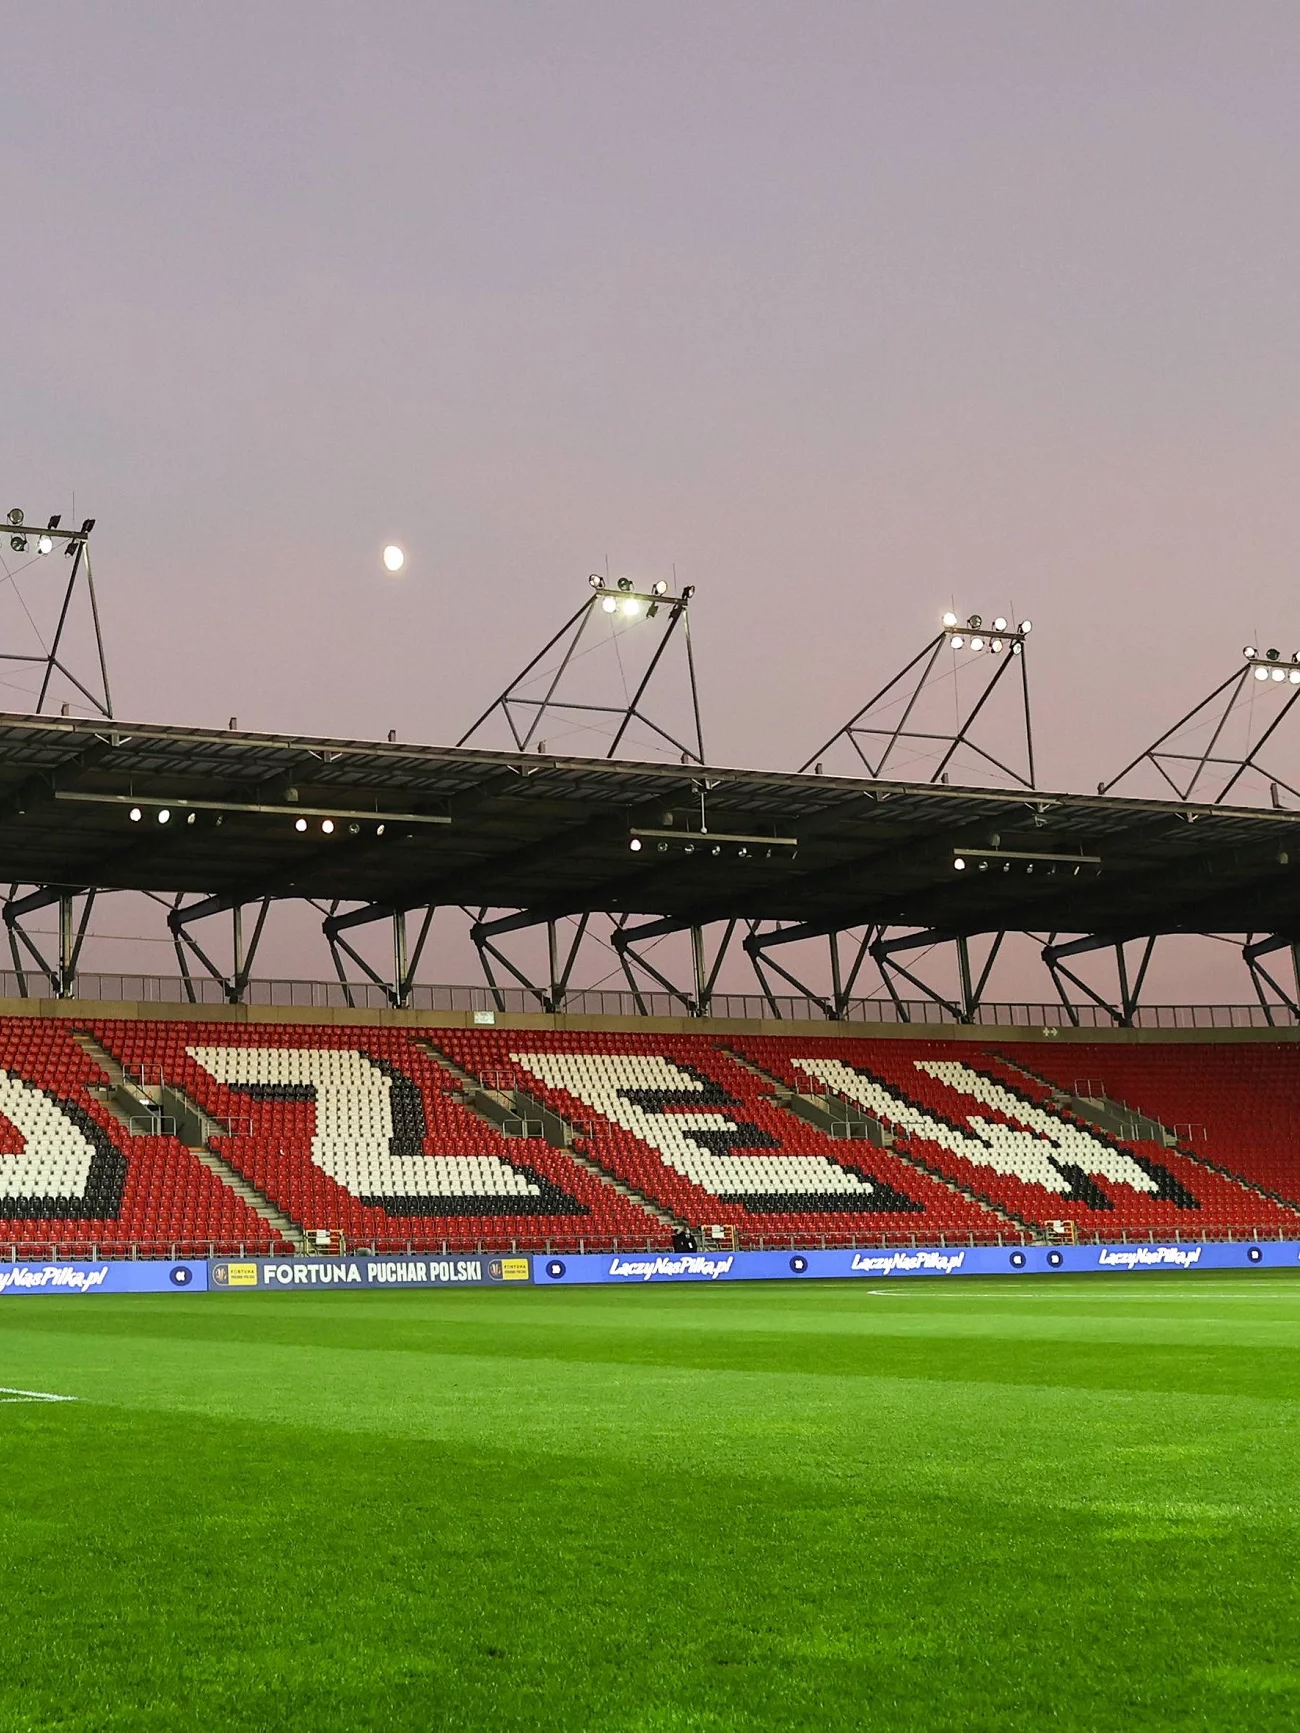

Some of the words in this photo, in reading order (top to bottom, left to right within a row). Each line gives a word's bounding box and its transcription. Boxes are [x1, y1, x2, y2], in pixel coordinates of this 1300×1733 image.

[263, 1263, 362, 1284] FORTUNA
[367, 1262, 427, 1283] PUCHAR
[429, 1261, 482, 1282] POLSKI
